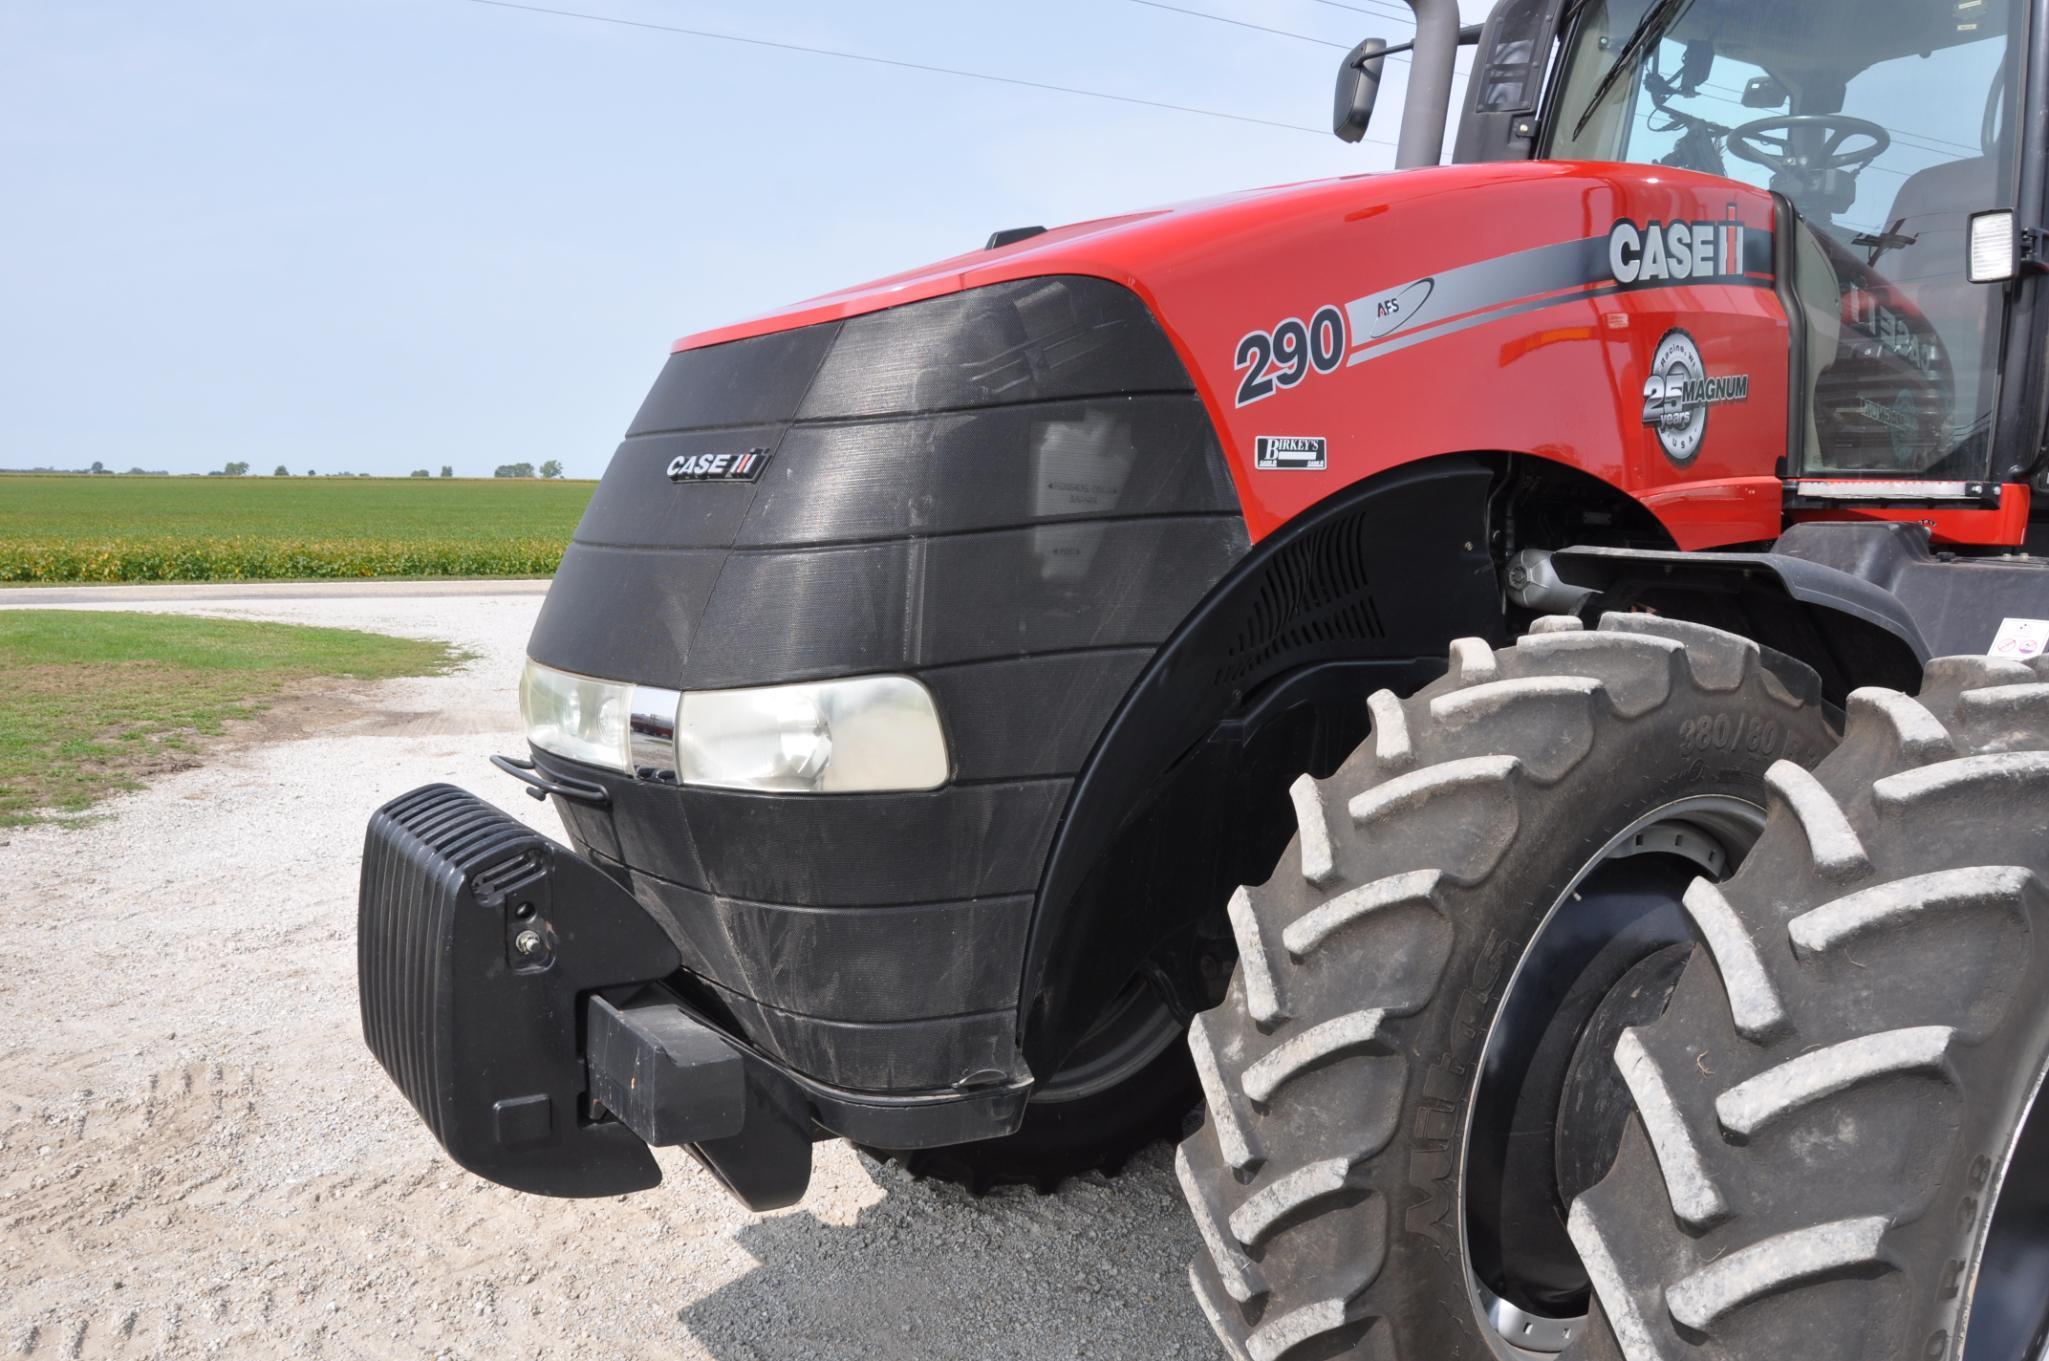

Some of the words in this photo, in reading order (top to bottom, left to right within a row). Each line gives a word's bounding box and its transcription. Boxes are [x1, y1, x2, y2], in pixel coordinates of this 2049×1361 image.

[1376, 298, 1400, 318] AFS
[1234, 303, 1346, 409] 290
[1642, 373, 1685, 424] 25
[1681, 375, 1749, 404] MAGNUM
[1659, 410, 1691, 430] years
[1264, 438, 1319, 460] BIRKEY'S
